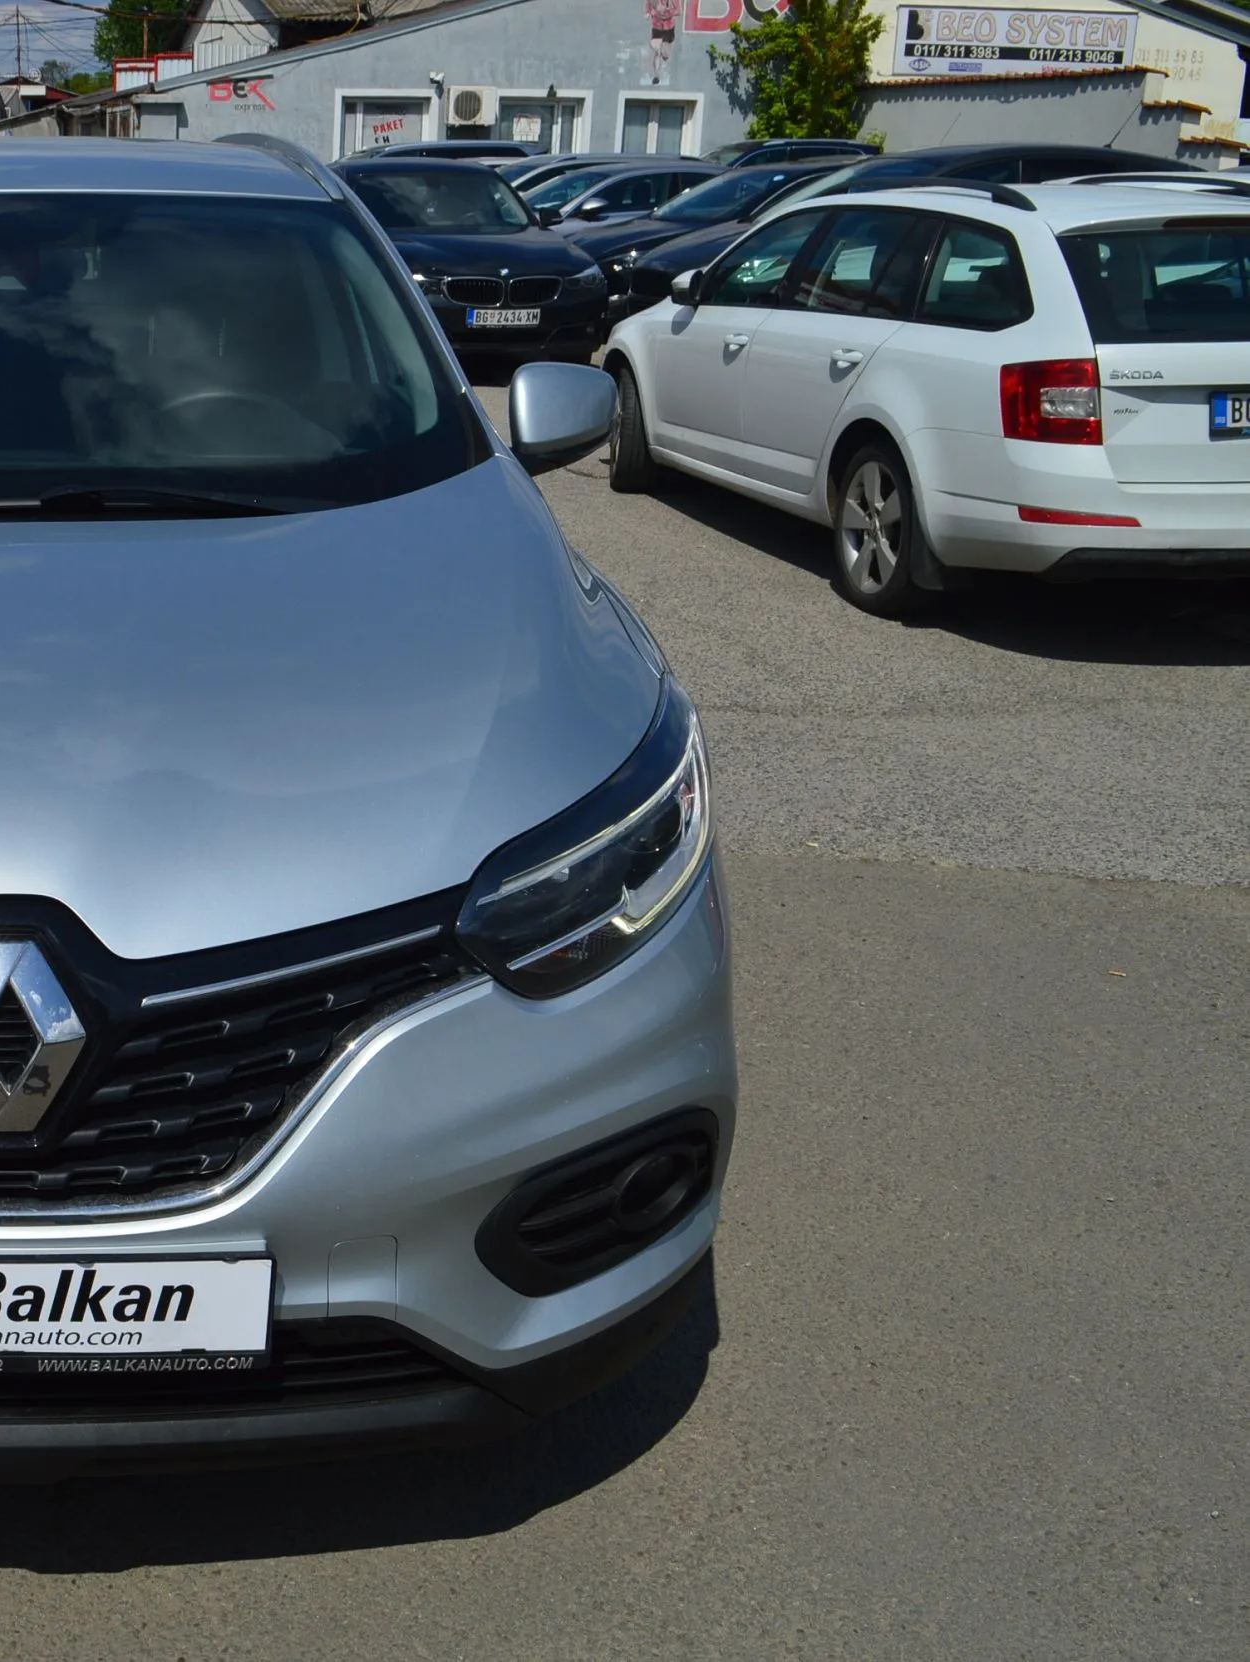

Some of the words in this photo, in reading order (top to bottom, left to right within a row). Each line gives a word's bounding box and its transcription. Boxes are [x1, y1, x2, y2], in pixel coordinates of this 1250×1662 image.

[936, 11, 997, 43] BEO
[1006, 13, 1128, 48] SYSTEM
[913, 44, 941, 57] 011/
[944, 46, 966, 58] 311
[969, 46, 1000, 59] 3983
[1029, 48, 1057, 61] 011/
[1058, 50, 1082, 62] 213
[1085, 51, 1115, 63] 9046
[372, 118, 405, 135] PAKET
[475, 311, 489, 323] BG
[1110, 369, 1164, 380] ŠKODA
[37, 1356, 254, 1372] WWW.BALKANAUTO.COM
